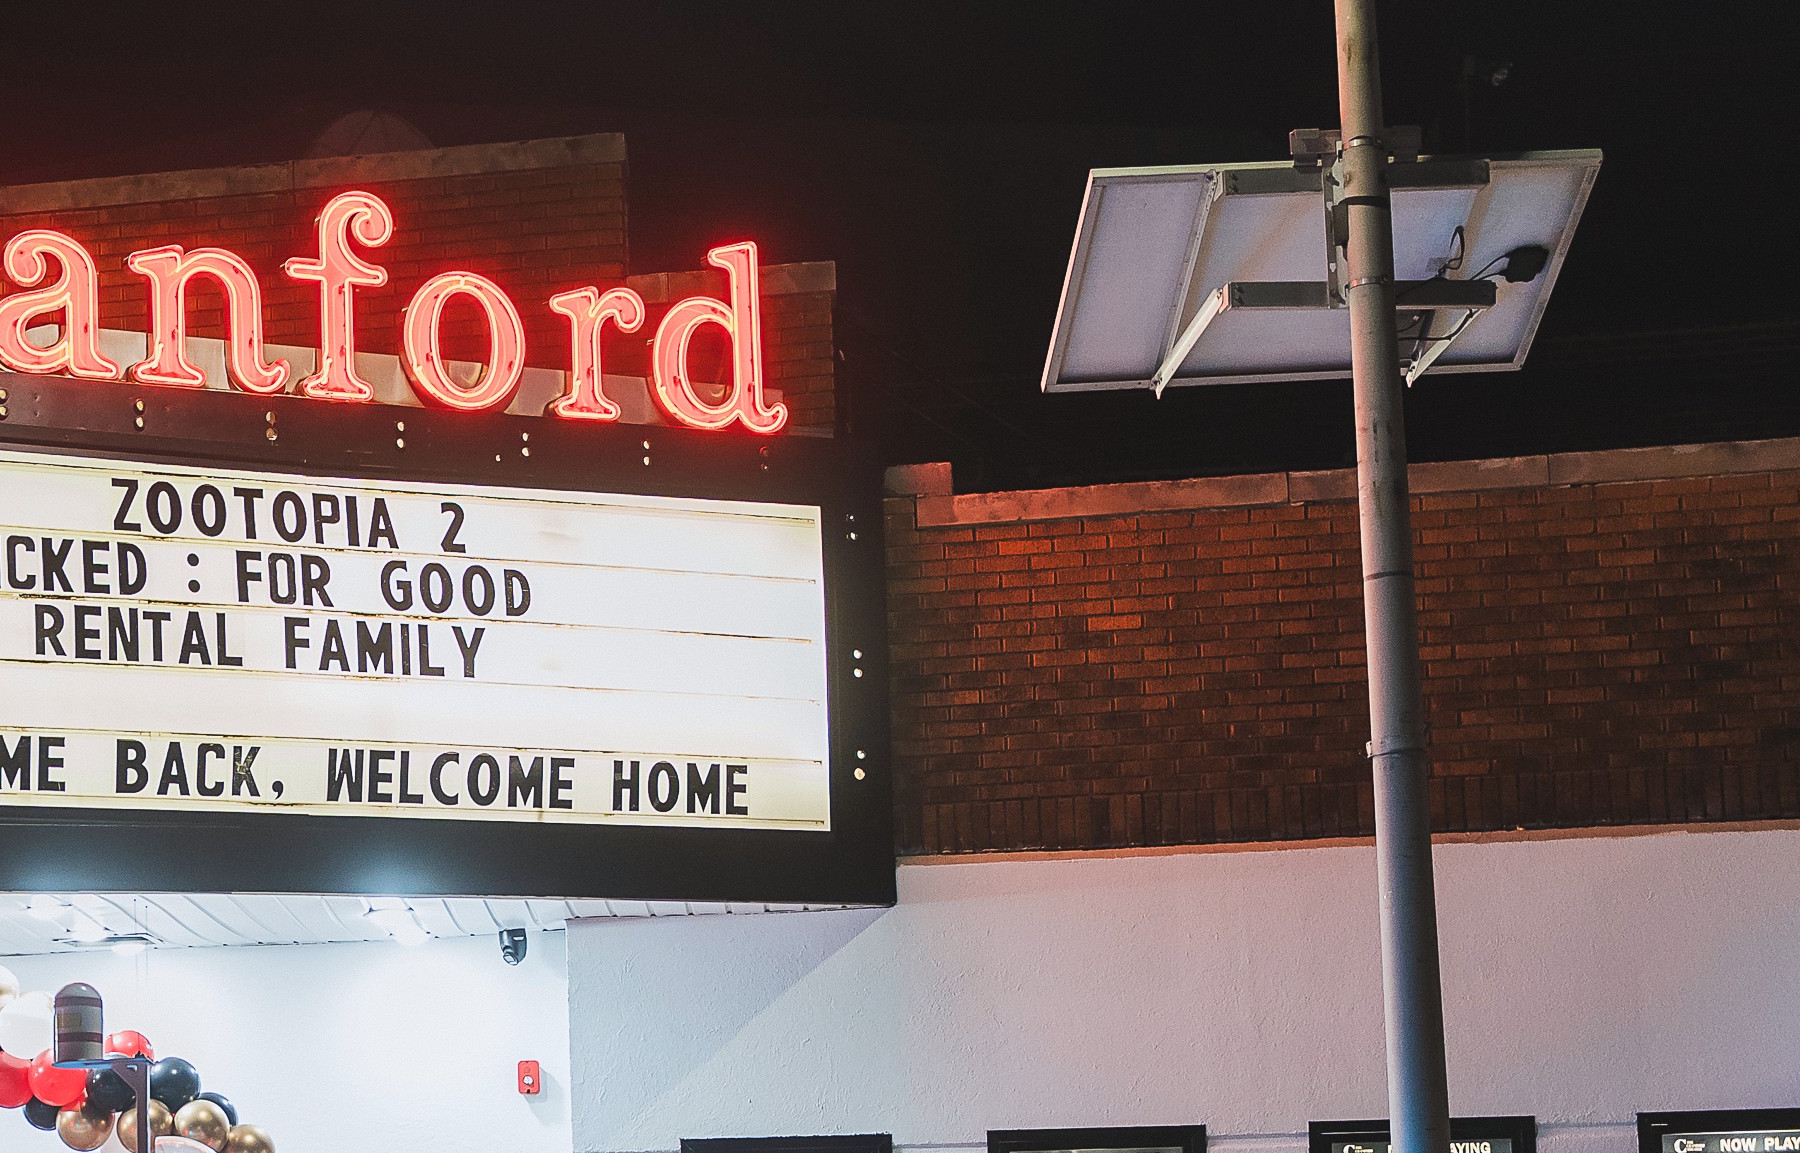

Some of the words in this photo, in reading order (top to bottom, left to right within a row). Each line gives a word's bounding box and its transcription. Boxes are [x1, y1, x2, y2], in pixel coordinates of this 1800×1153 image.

[111, 478, 399, 549] ZOOTOPIA
[440, 502, 467, 553] 2
[235, 549, 335, 608] FOR
[380, 560, 532, 617] GOOD
[35, 604, 243, 667] RENTAL
[283, 616, 487, 679] FAMILY
[116, 738, 285, 801] BACK,
[326, 747, 576, 810] WELCOME
[612, 759, 750, 817] HOME
[1720, 1138, 1757, 1152] NOW
